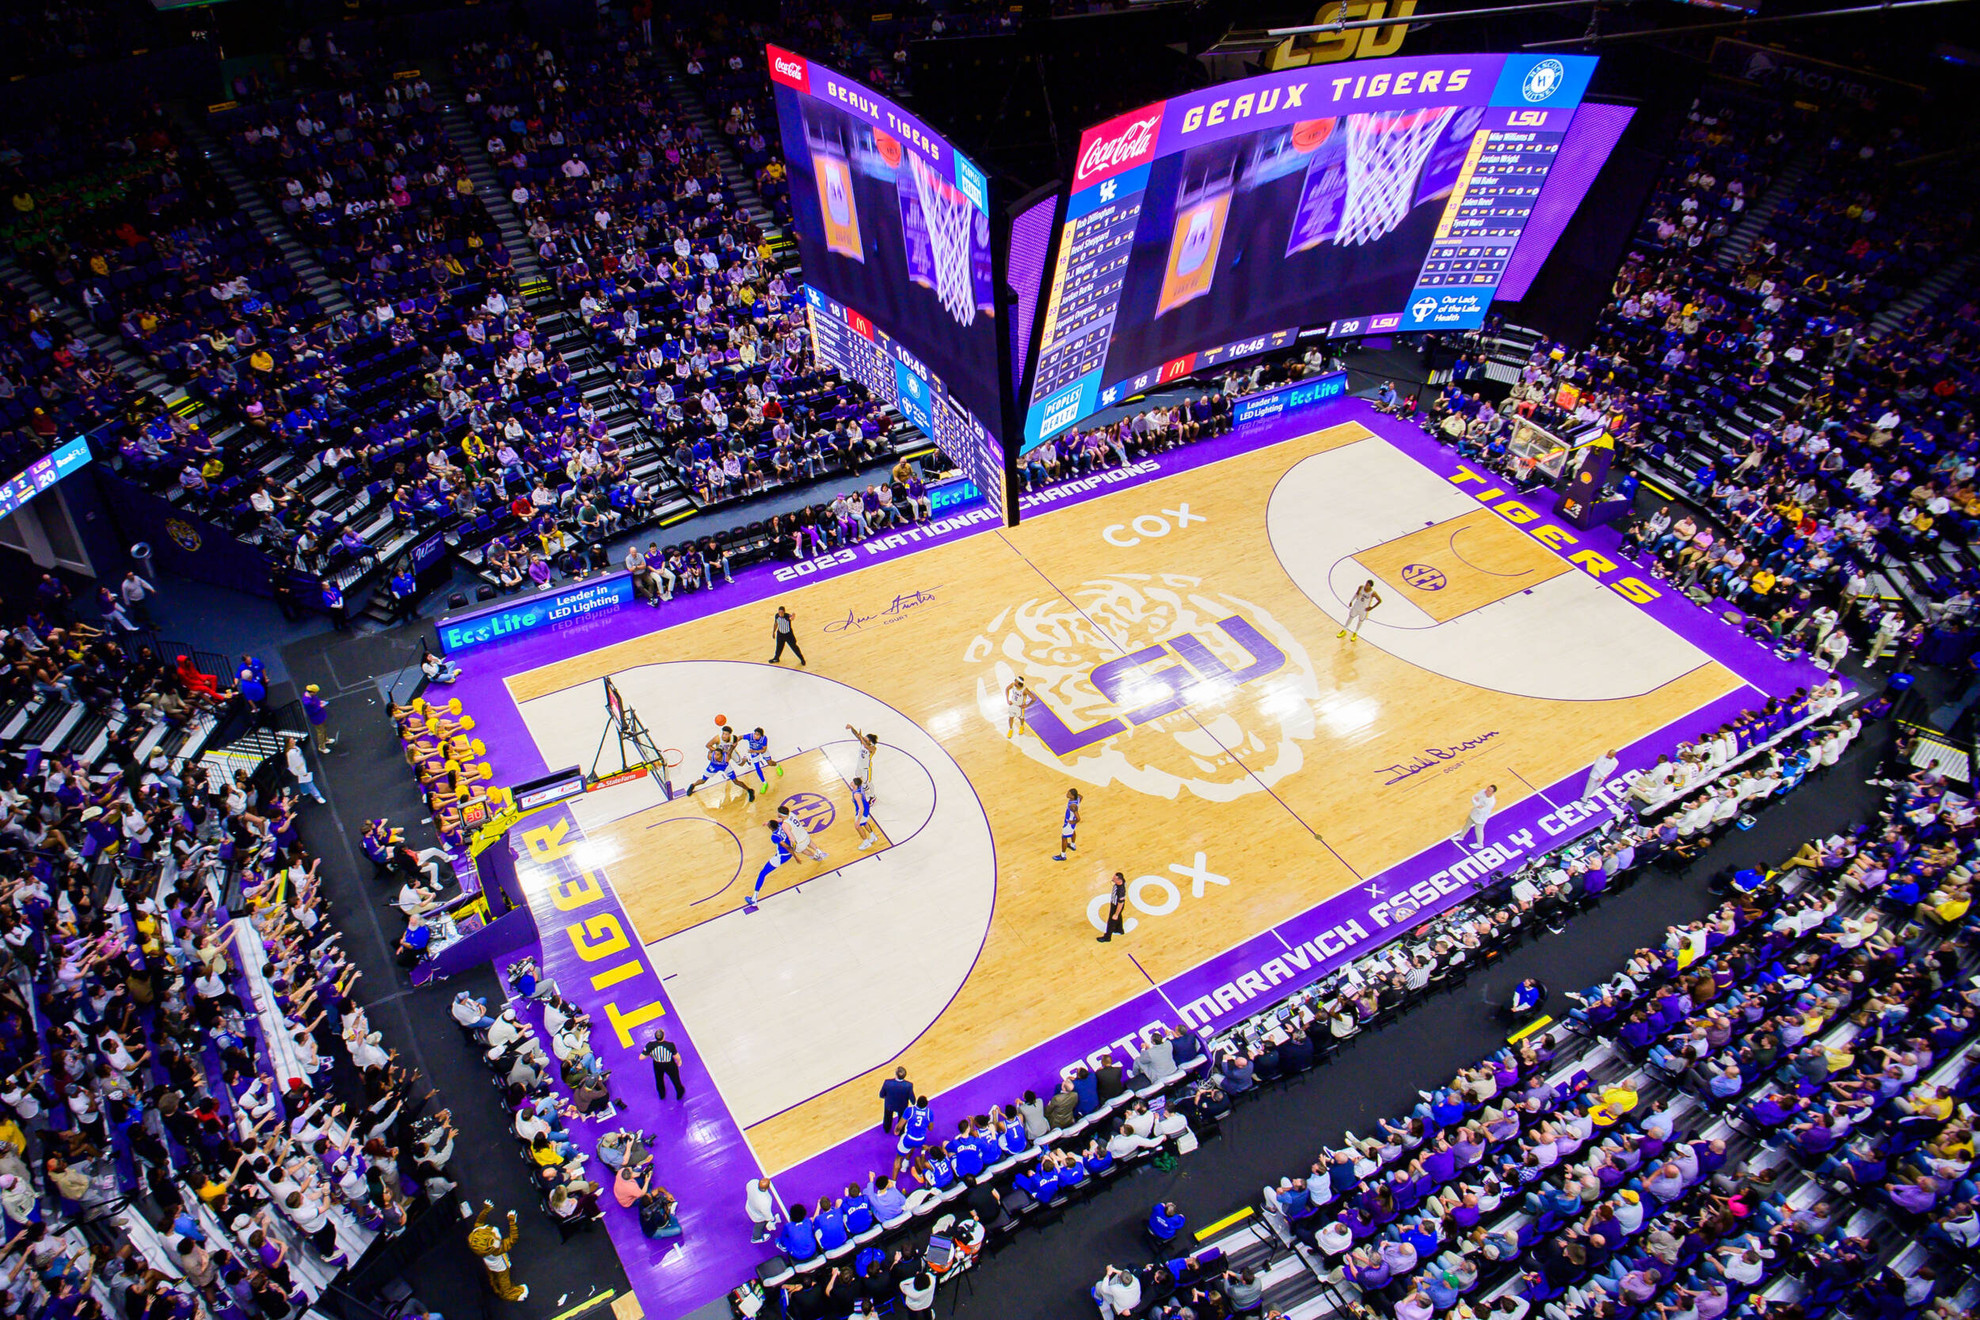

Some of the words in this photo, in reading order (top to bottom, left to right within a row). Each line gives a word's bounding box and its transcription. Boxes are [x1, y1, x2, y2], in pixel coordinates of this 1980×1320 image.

[1265, 0, 1417, 71] LSU
[775, 57, 802, 81] Coca-Cola
[1181, 83, 1309, 134] GEAUX
[1331, 68, 1472, 102] TIGERS
[828, 81, 879, 119] GEAUX
[887, 112, 939, 161] TIGERS
[1507, 111, 1548, 126] LSU
[1077, 114, 1161, 180] Coca-Cola
[829, 302, 840, 317] 18
[1438, 305, 1447, 313] of
[1448, 305, 1461, 313] the
[1462, 305, 1481, 313] Lake
[1442, 296, 1458, 304] Our
[1458, 295, 1479, 305] Lady
[1340, 321, 1360, 334] 20
[1371, 317, 1399, 329] LSU
[1434, 314, 1460, 322] Health
[1229, 338, 1265, 357] 10:45
[896, 345, 927, 381] 10:45
[1208, 355, 1214, 364] 1
[1134, 375, 1148, 390] 18
[1046, 388, 1080, 418] PEOPLES
[1240, 411, 1253, 421] LED
[1254, 403, 1283, 418] Lighting
[1247, 397, 1271, 410] Leader
[1271, 395, 1279, 405] in
[33, 459, 52, 474] LSU
[38, 469, 56, 488] 20
[1102, 502, 1208, 547] COX
[1447, 465, 1662, 604] TIGERS
[772, 549, 858, 583] 2023
[863, 506, 1001, 555] NATIONAL
[557, 588, 595, 607] Leader
[597, 584, 608, 596] in
[548, 606, 571, 620] LED
[572, 594, 619, 615] Lighting
[884, 614, 908, 625] COURT
[1023, 614, 1287, 759] LSU
[1426, 730, 1500, 759] Brown
[1443, 760, 1466, 774] COURT
[467, 810, 482, 822] 30
[1086, 851, 1231, 935] COX
[505, 789, 666, 1049] TIGER
[1178, 918, 1369, 1030] MARAVICH
[915, 1115, 923, 1127] 3
[1012, 1127, 1019, 1139] 1
[937, 1162, 949, 1176] 12
